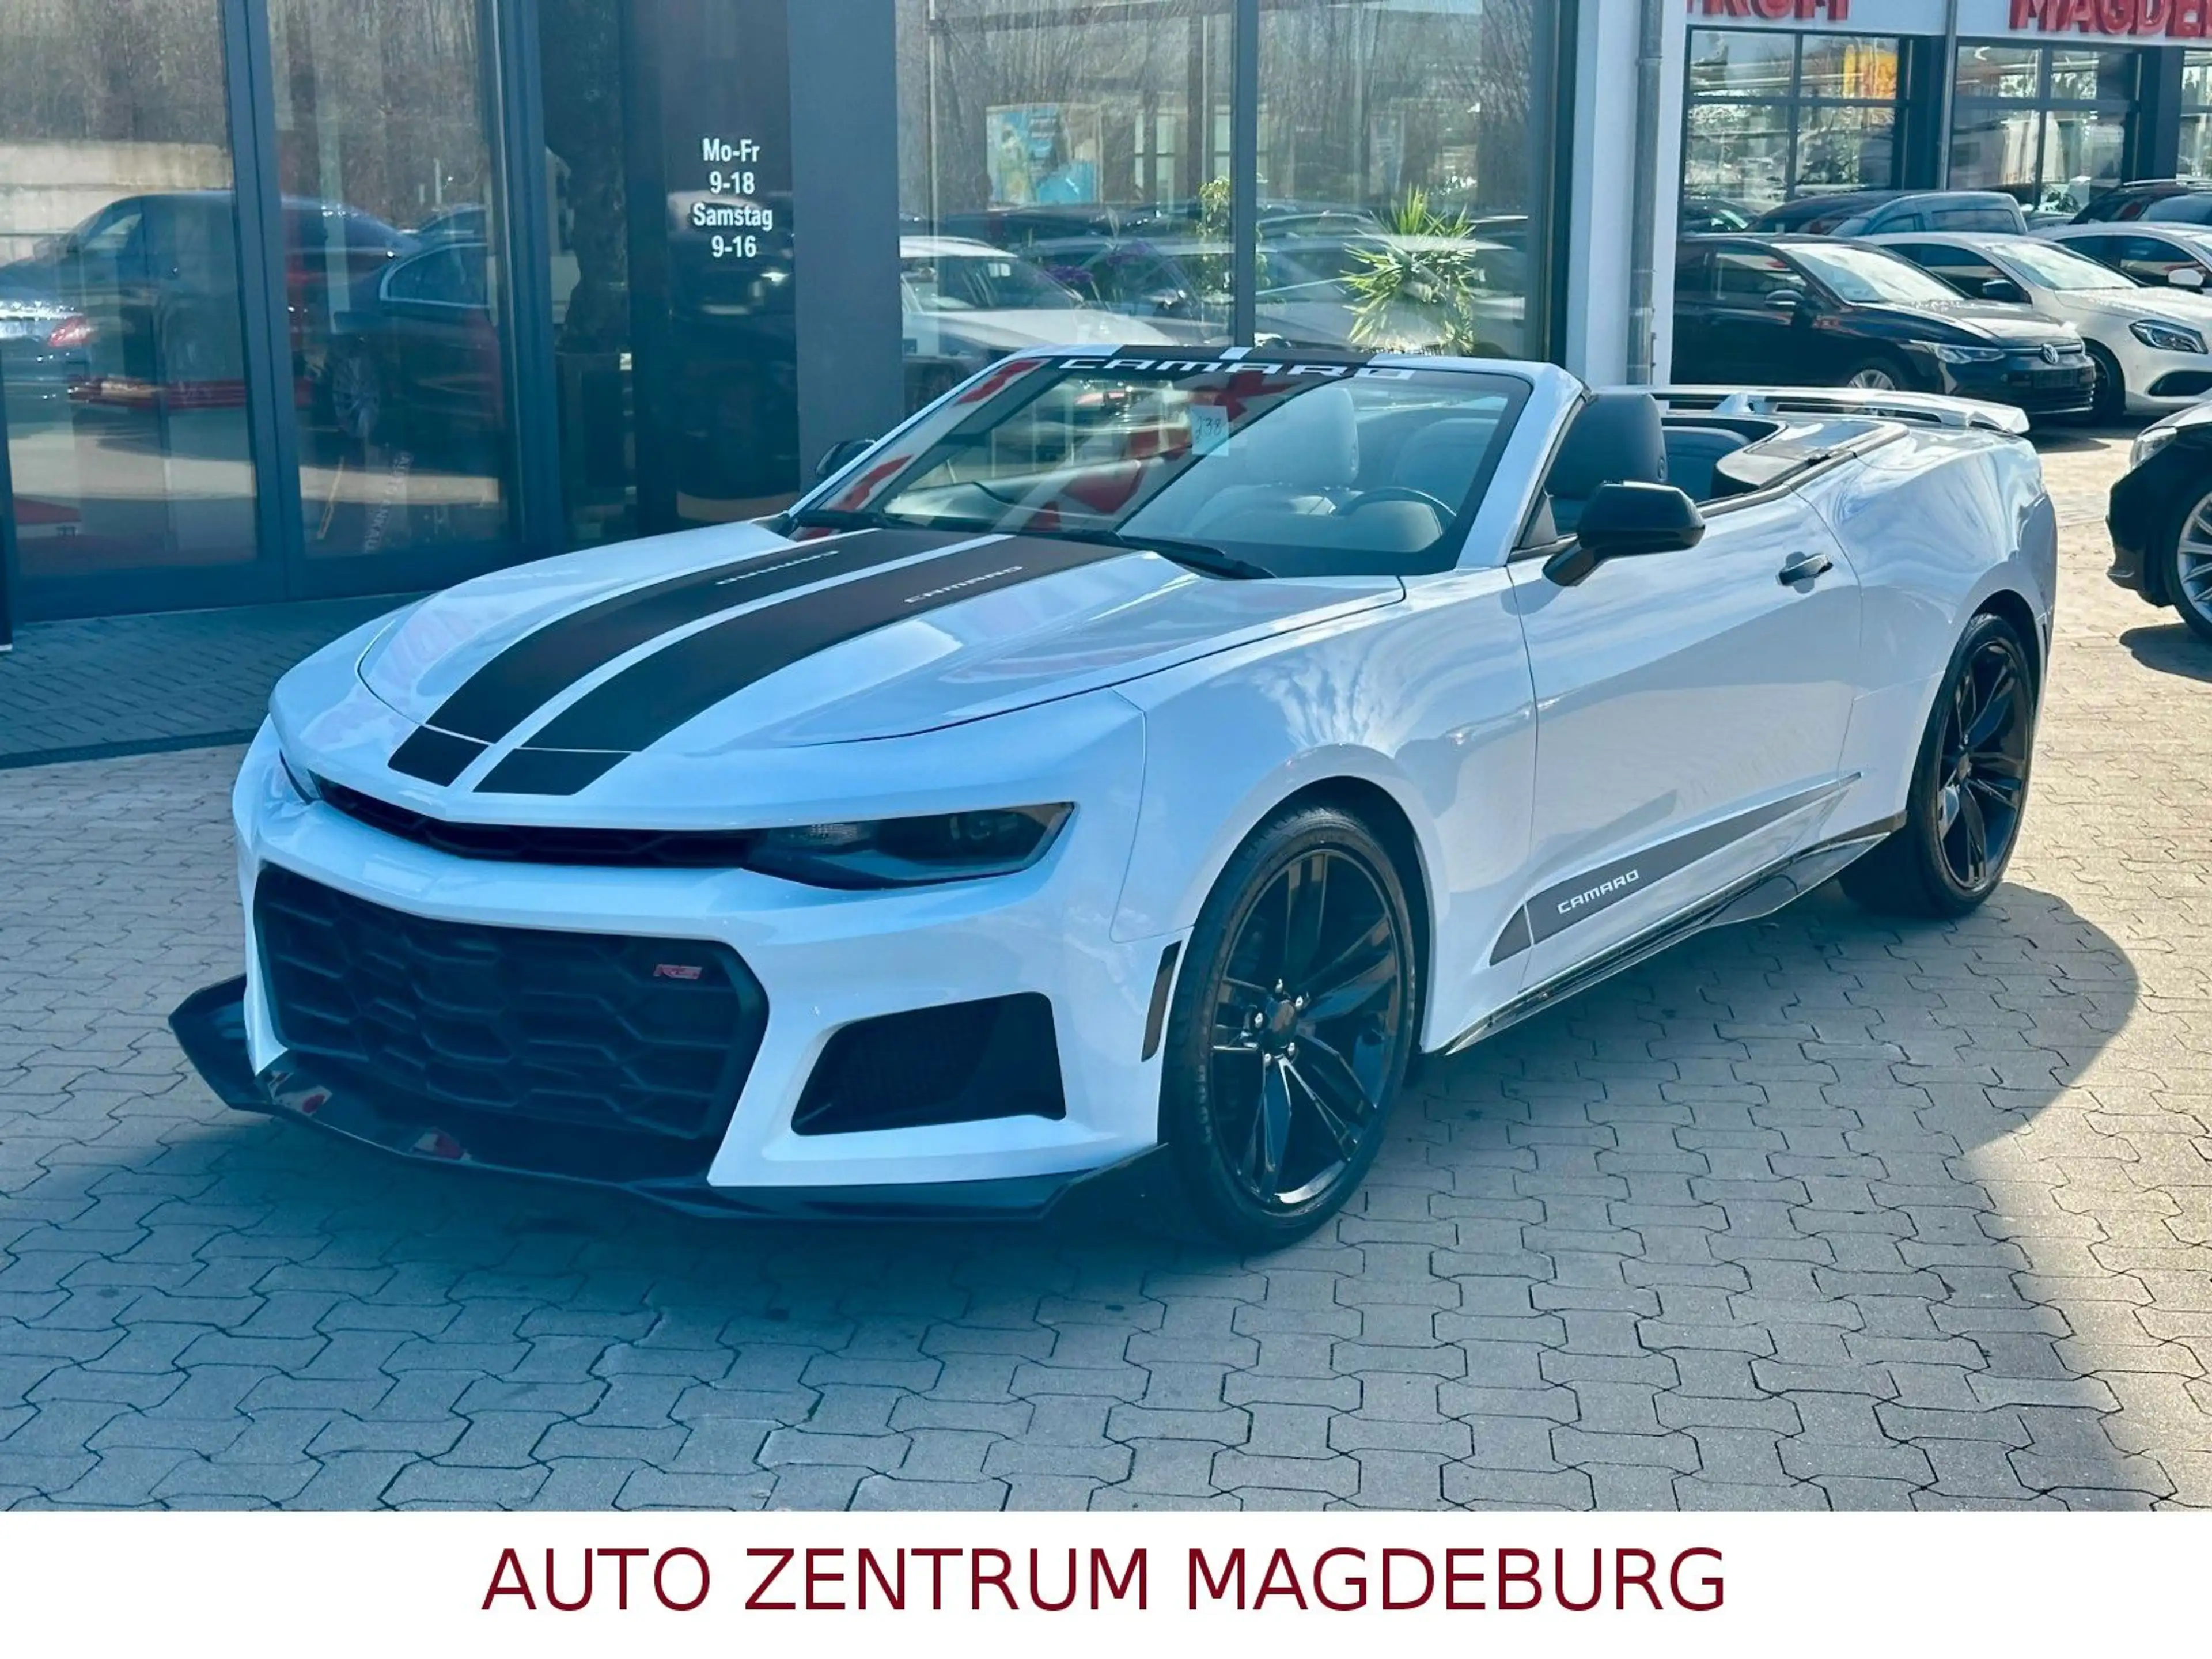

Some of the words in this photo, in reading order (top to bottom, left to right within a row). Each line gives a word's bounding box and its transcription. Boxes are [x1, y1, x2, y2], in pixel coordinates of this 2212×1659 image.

[702, 138, 760, 162] Mo-Fr
[710, 171, 755, 195] 9-18
[693, 203, 773, 231] Samstag
[711, 236, 757, 258] 9-16
[1059, 359, 1416, 380] CAMARO
[1557, 869, 1640, 915] CAMARO
